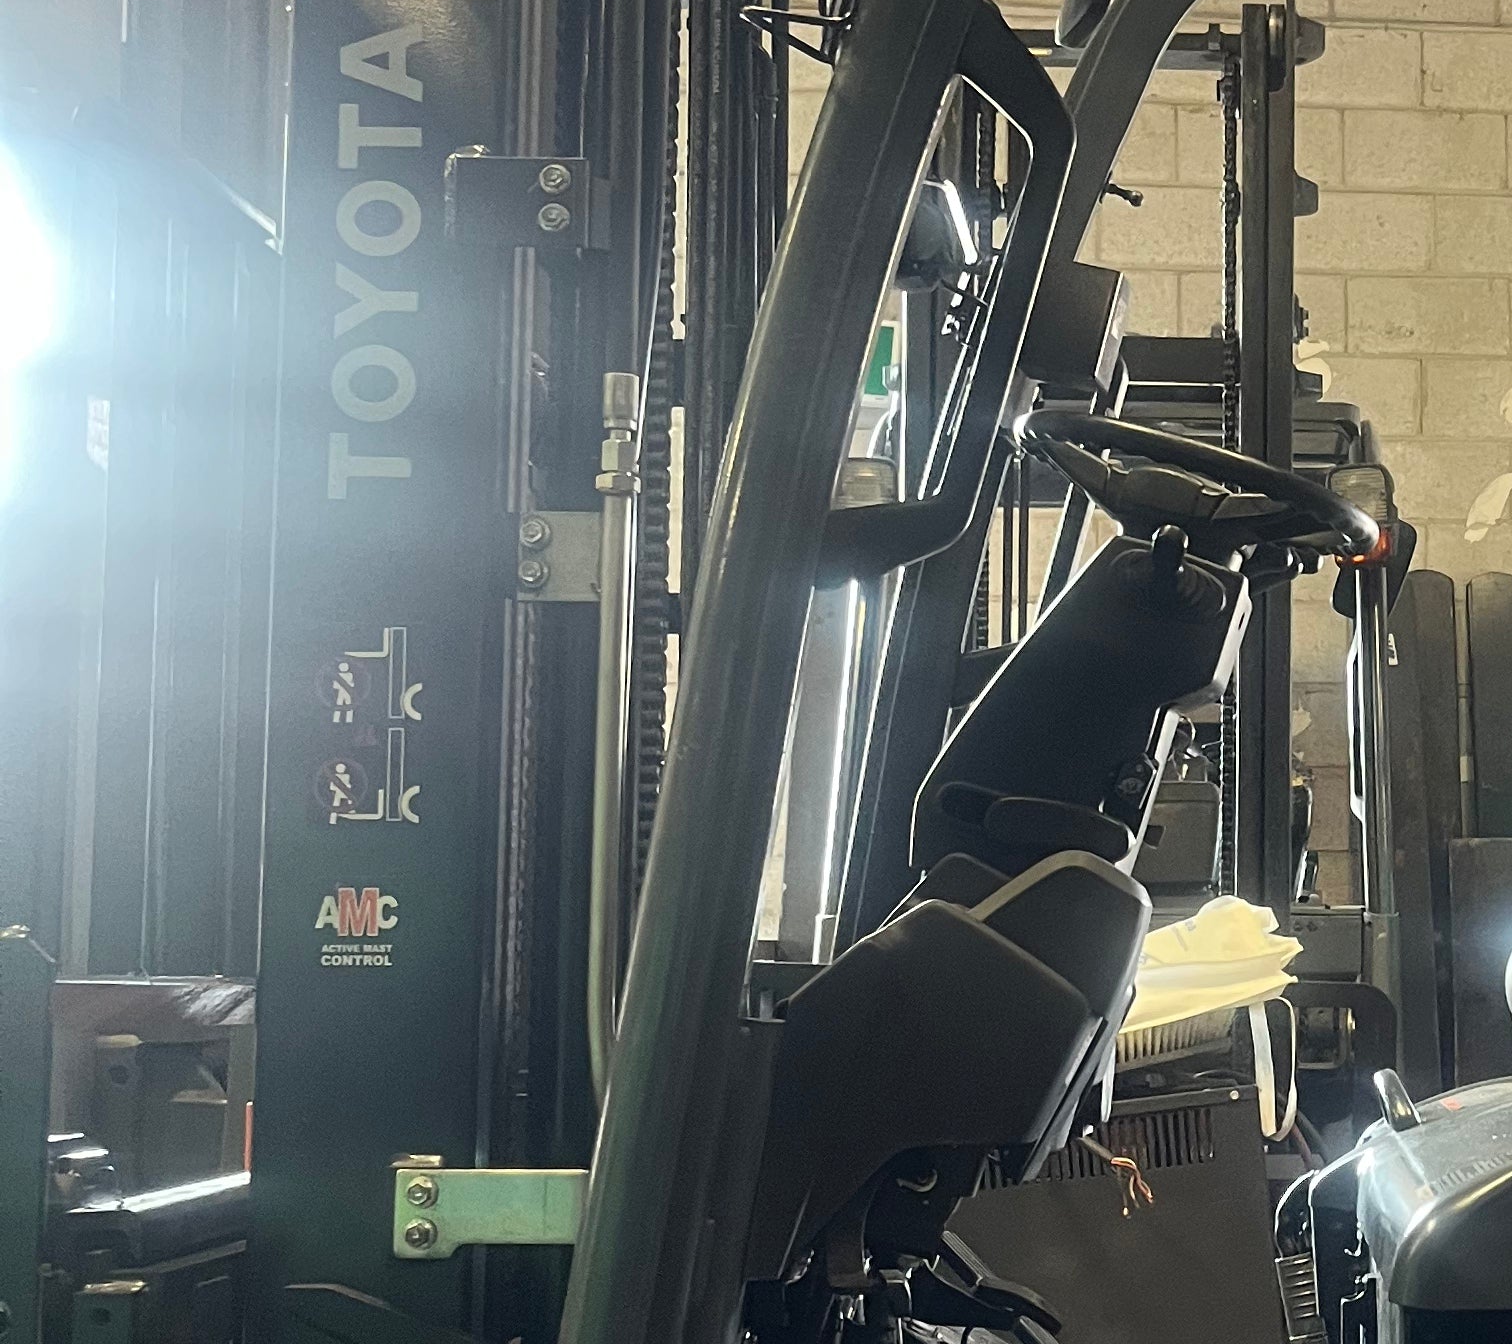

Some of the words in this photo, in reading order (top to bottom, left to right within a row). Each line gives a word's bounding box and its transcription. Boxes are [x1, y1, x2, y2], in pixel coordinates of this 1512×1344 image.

[326, 25, 424, 500] TOYOTA
[314, 887, 399, 937] AMC
[320, 954, 393, 966] CONTROL
[321, 944, 360, 953] ACTIVE
[363, 944, 393, 953] MAST
